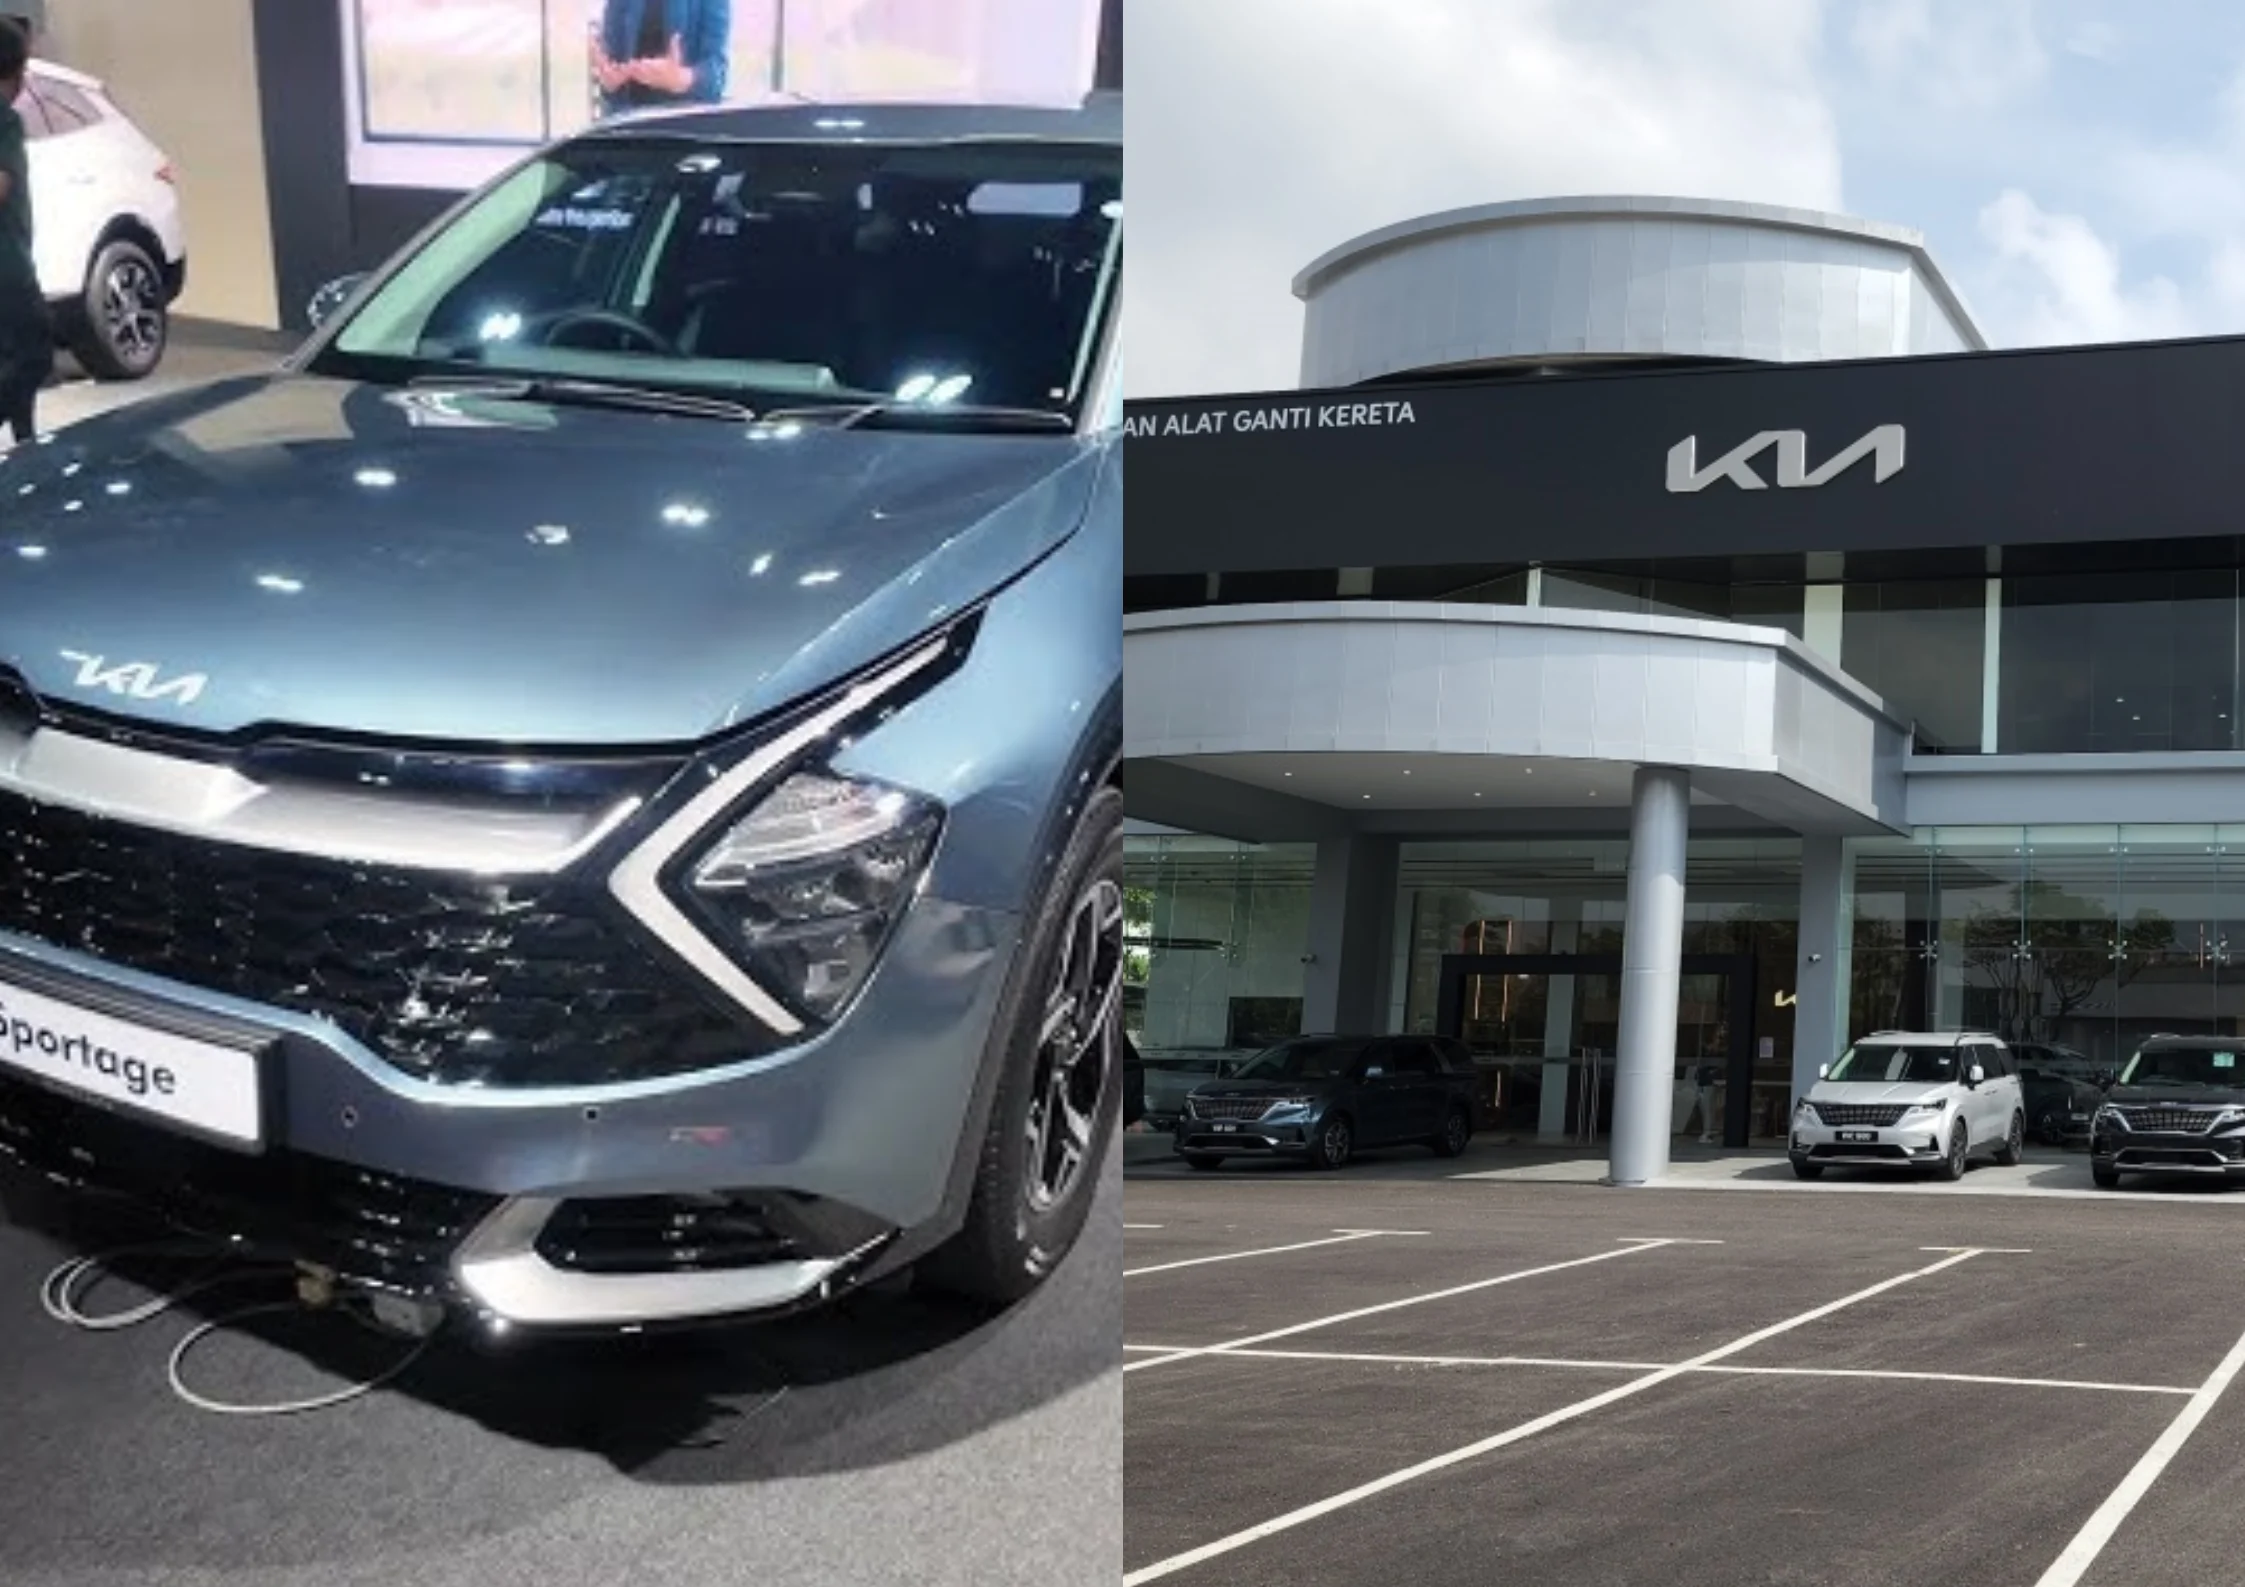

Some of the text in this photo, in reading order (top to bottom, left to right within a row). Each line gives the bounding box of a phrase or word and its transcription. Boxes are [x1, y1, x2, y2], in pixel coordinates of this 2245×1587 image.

[1122, 401, 1416, 437] AN ALAT GANTI KERETA
[1665, 423, 1906, 493] KIA
